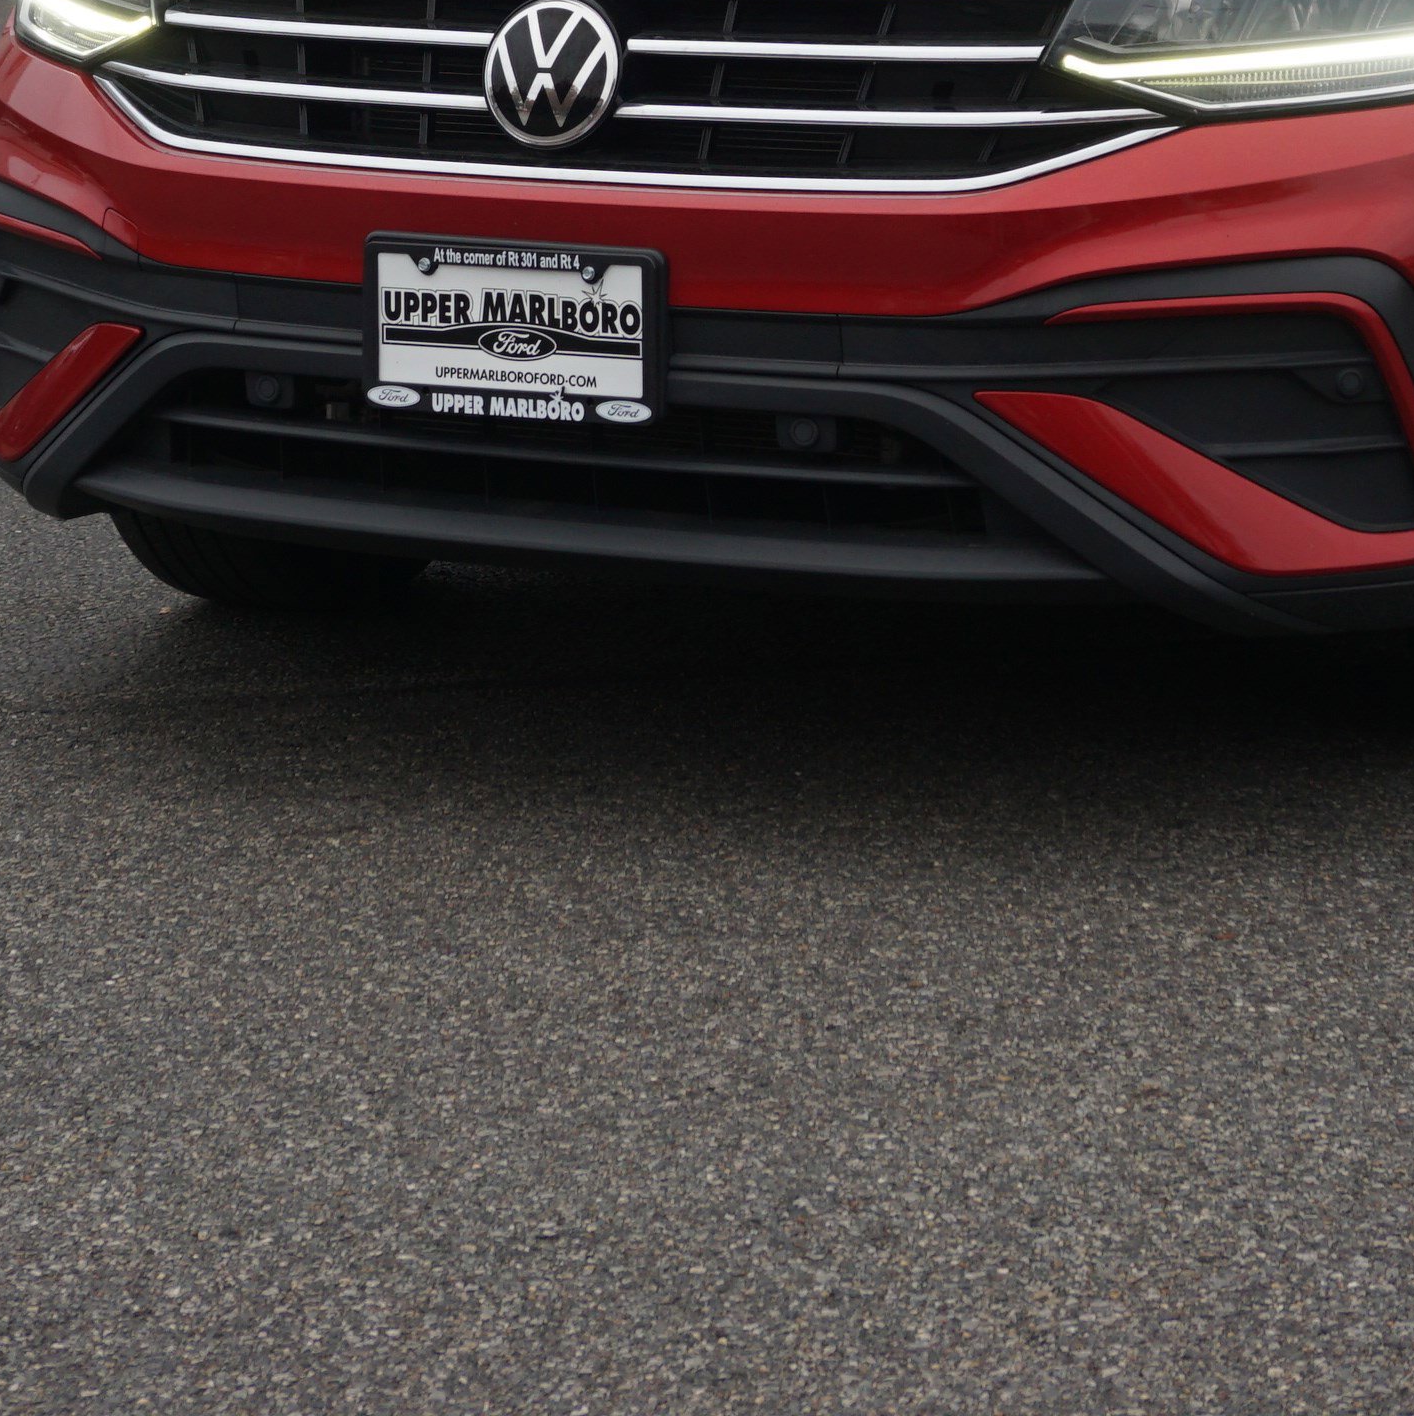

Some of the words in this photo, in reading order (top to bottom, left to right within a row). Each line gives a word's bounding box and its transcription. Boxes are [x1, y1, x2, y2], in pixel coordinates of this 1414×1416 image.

[433, 247, 444, 263] At
[446, 249, 461, 264] the
[463, 252, 494, 266] corner
[496, 251, 507, 266] of
[508, 251, 520, 267] Rt
[521, 252, 537, 268] 301
[539, 253, 558, 269] and
[560, 254, 572, 270] Rt
[573, 254, 580, 270] 4
[383, 288, 473, 324] UPPER
[481, 289, 642, 336] MARLBORO
[492, 330, 541, 356] Ford
[378, 388, 409, 403] Ford
[431, 392, 485, 416] UPPER
[489, 396, 585, 422] MARLBORO
[607, 403, 640, 418] Ford
